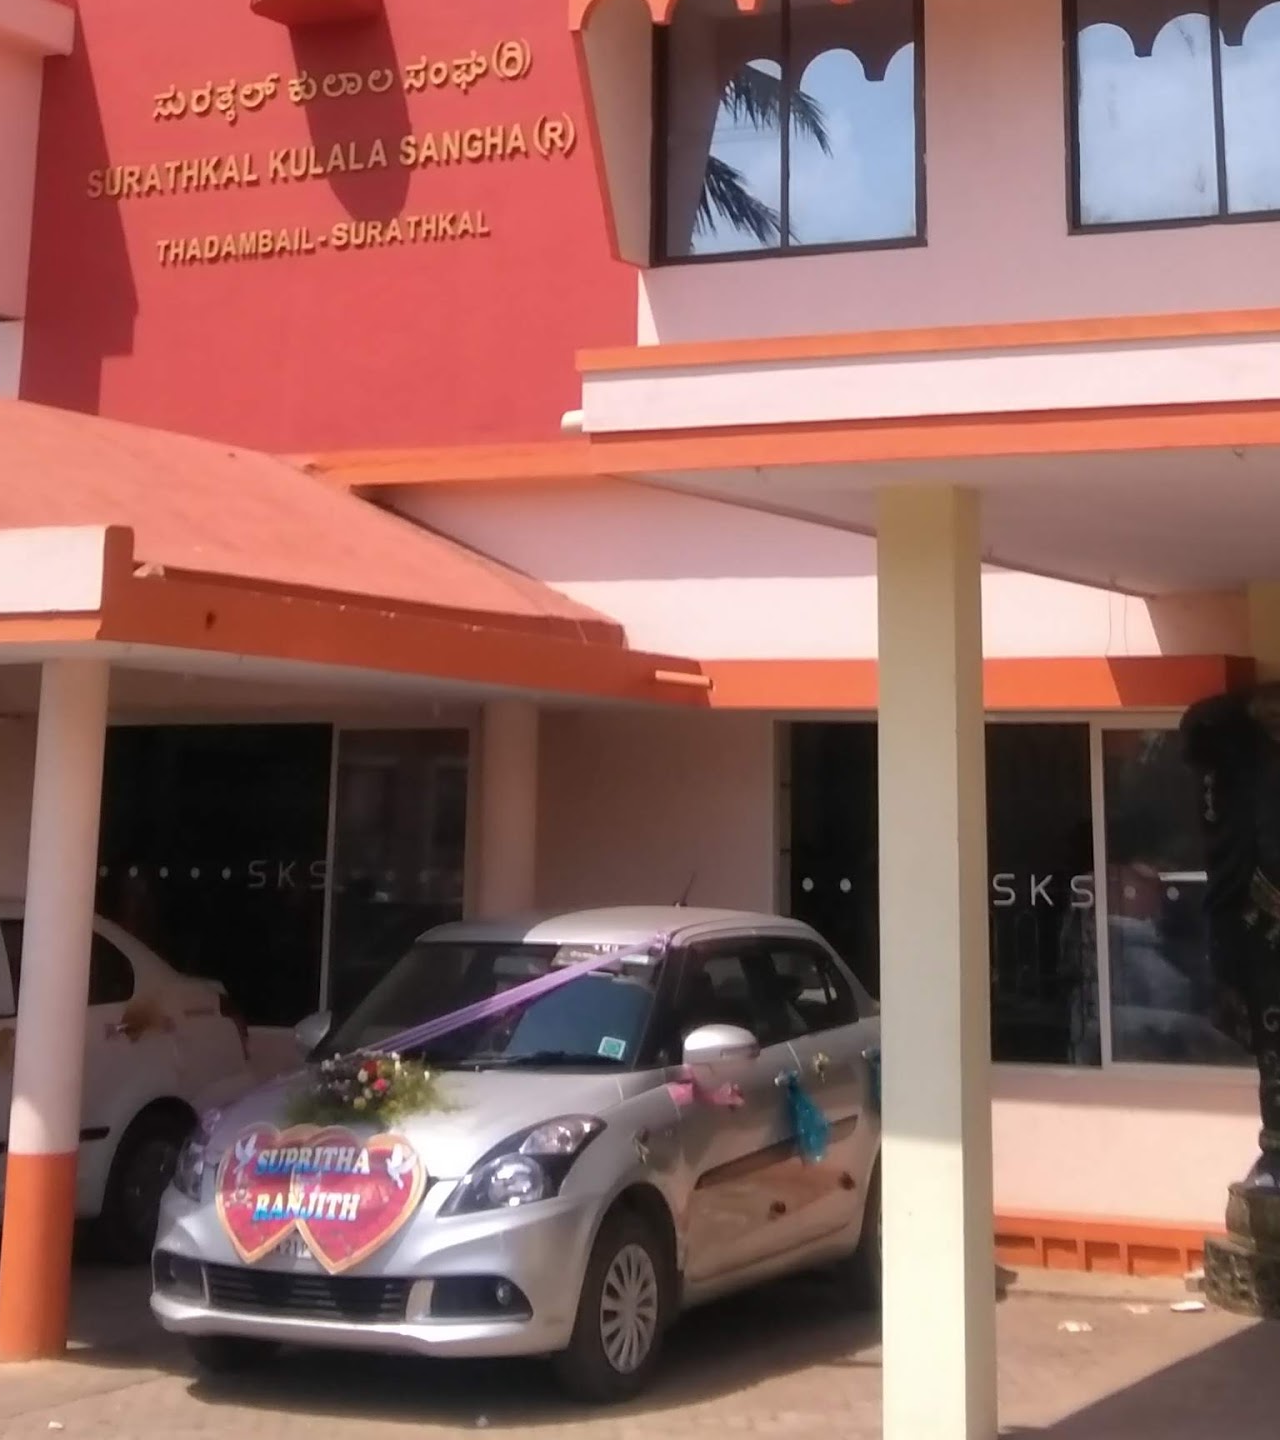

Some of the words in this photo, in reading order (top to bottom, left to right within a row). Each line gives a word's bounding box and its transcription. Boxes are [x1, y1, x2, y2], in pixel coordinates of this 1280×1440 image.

[287, 67, 394, 104] ಕುಲಾಲ
[86, 153, 260, 200] SURATHKAL
[268, 138, 389, 180] KULALA
[398, 123, 528, 167] SANGHA
[992, 873, 1094, 909] SKS
[255, 1146, 370, 1175] SUPRITHA
[253, 1190, 361, 1221] RANJITH
